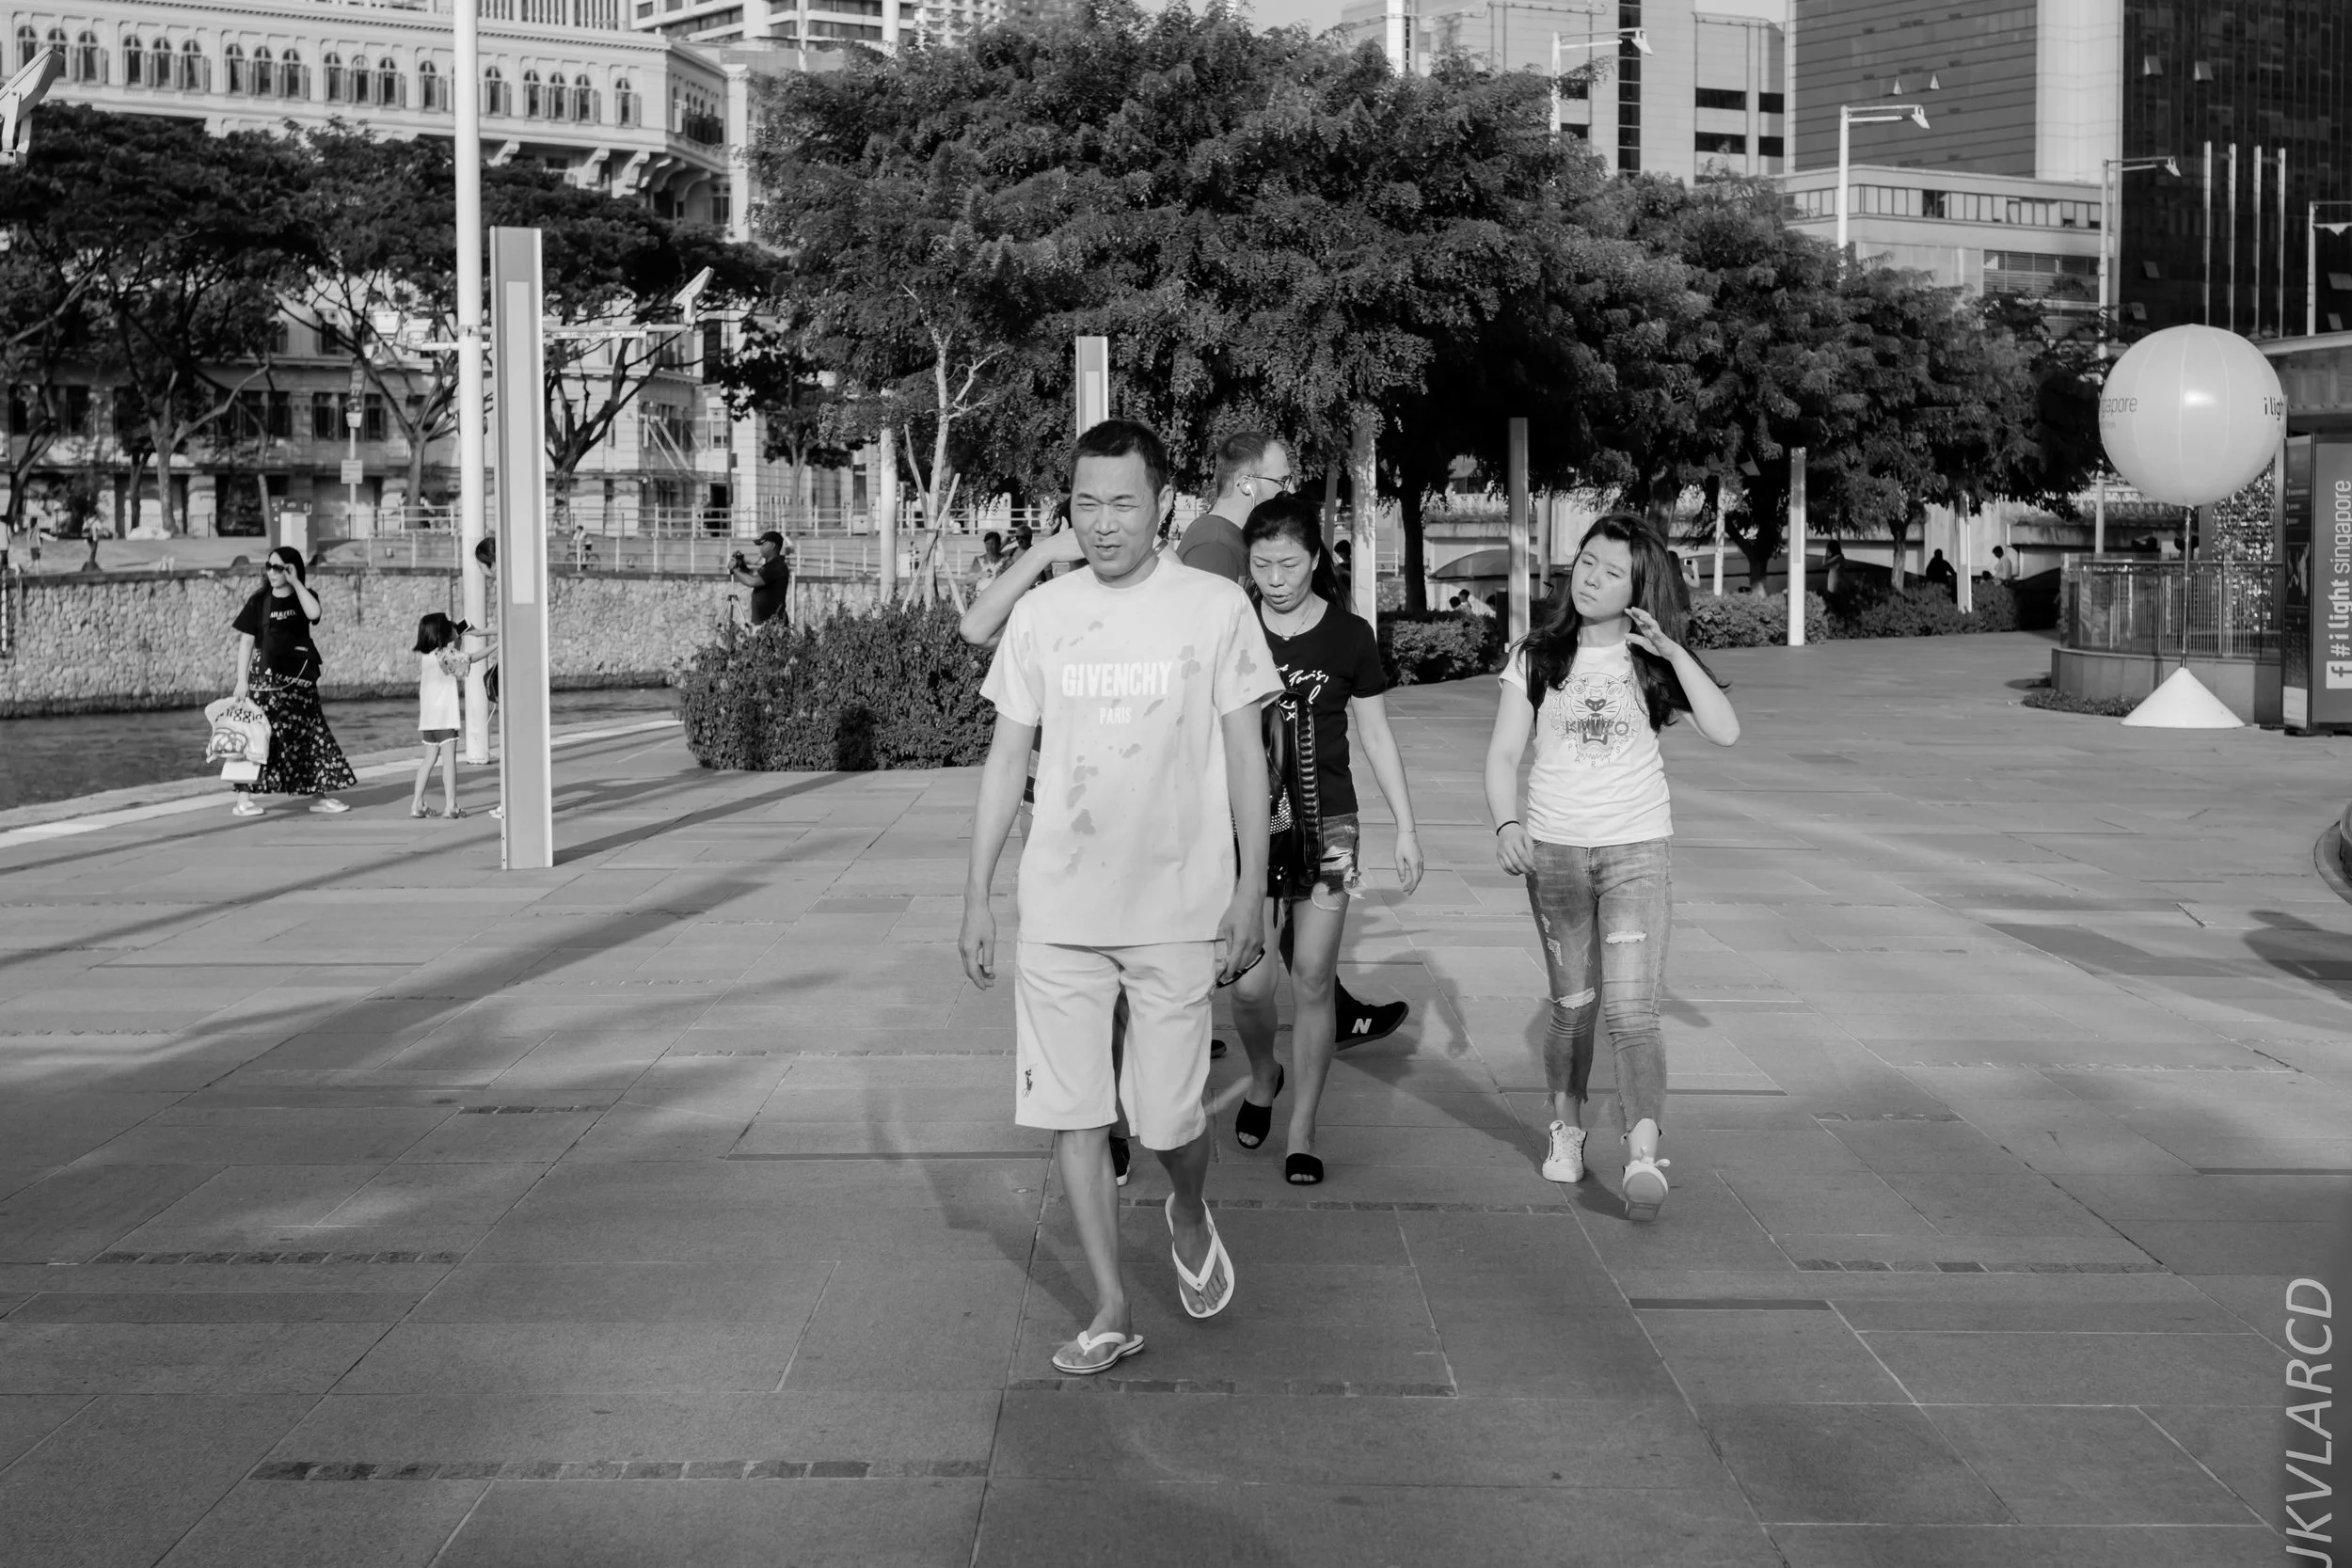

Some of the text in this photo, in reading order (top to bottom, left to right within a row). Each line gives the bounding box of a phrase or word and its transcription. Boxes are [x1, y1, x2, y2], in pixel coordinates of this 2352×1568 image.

[2329, 480, 2352, 574] singapore
[2327, 578, 2352, 629] light
[1061, 660, 1173, 697] GIVENCHY
[1099, 706, 1131, 724] PARIS
[1351, 1018, 1373, 1035] N
